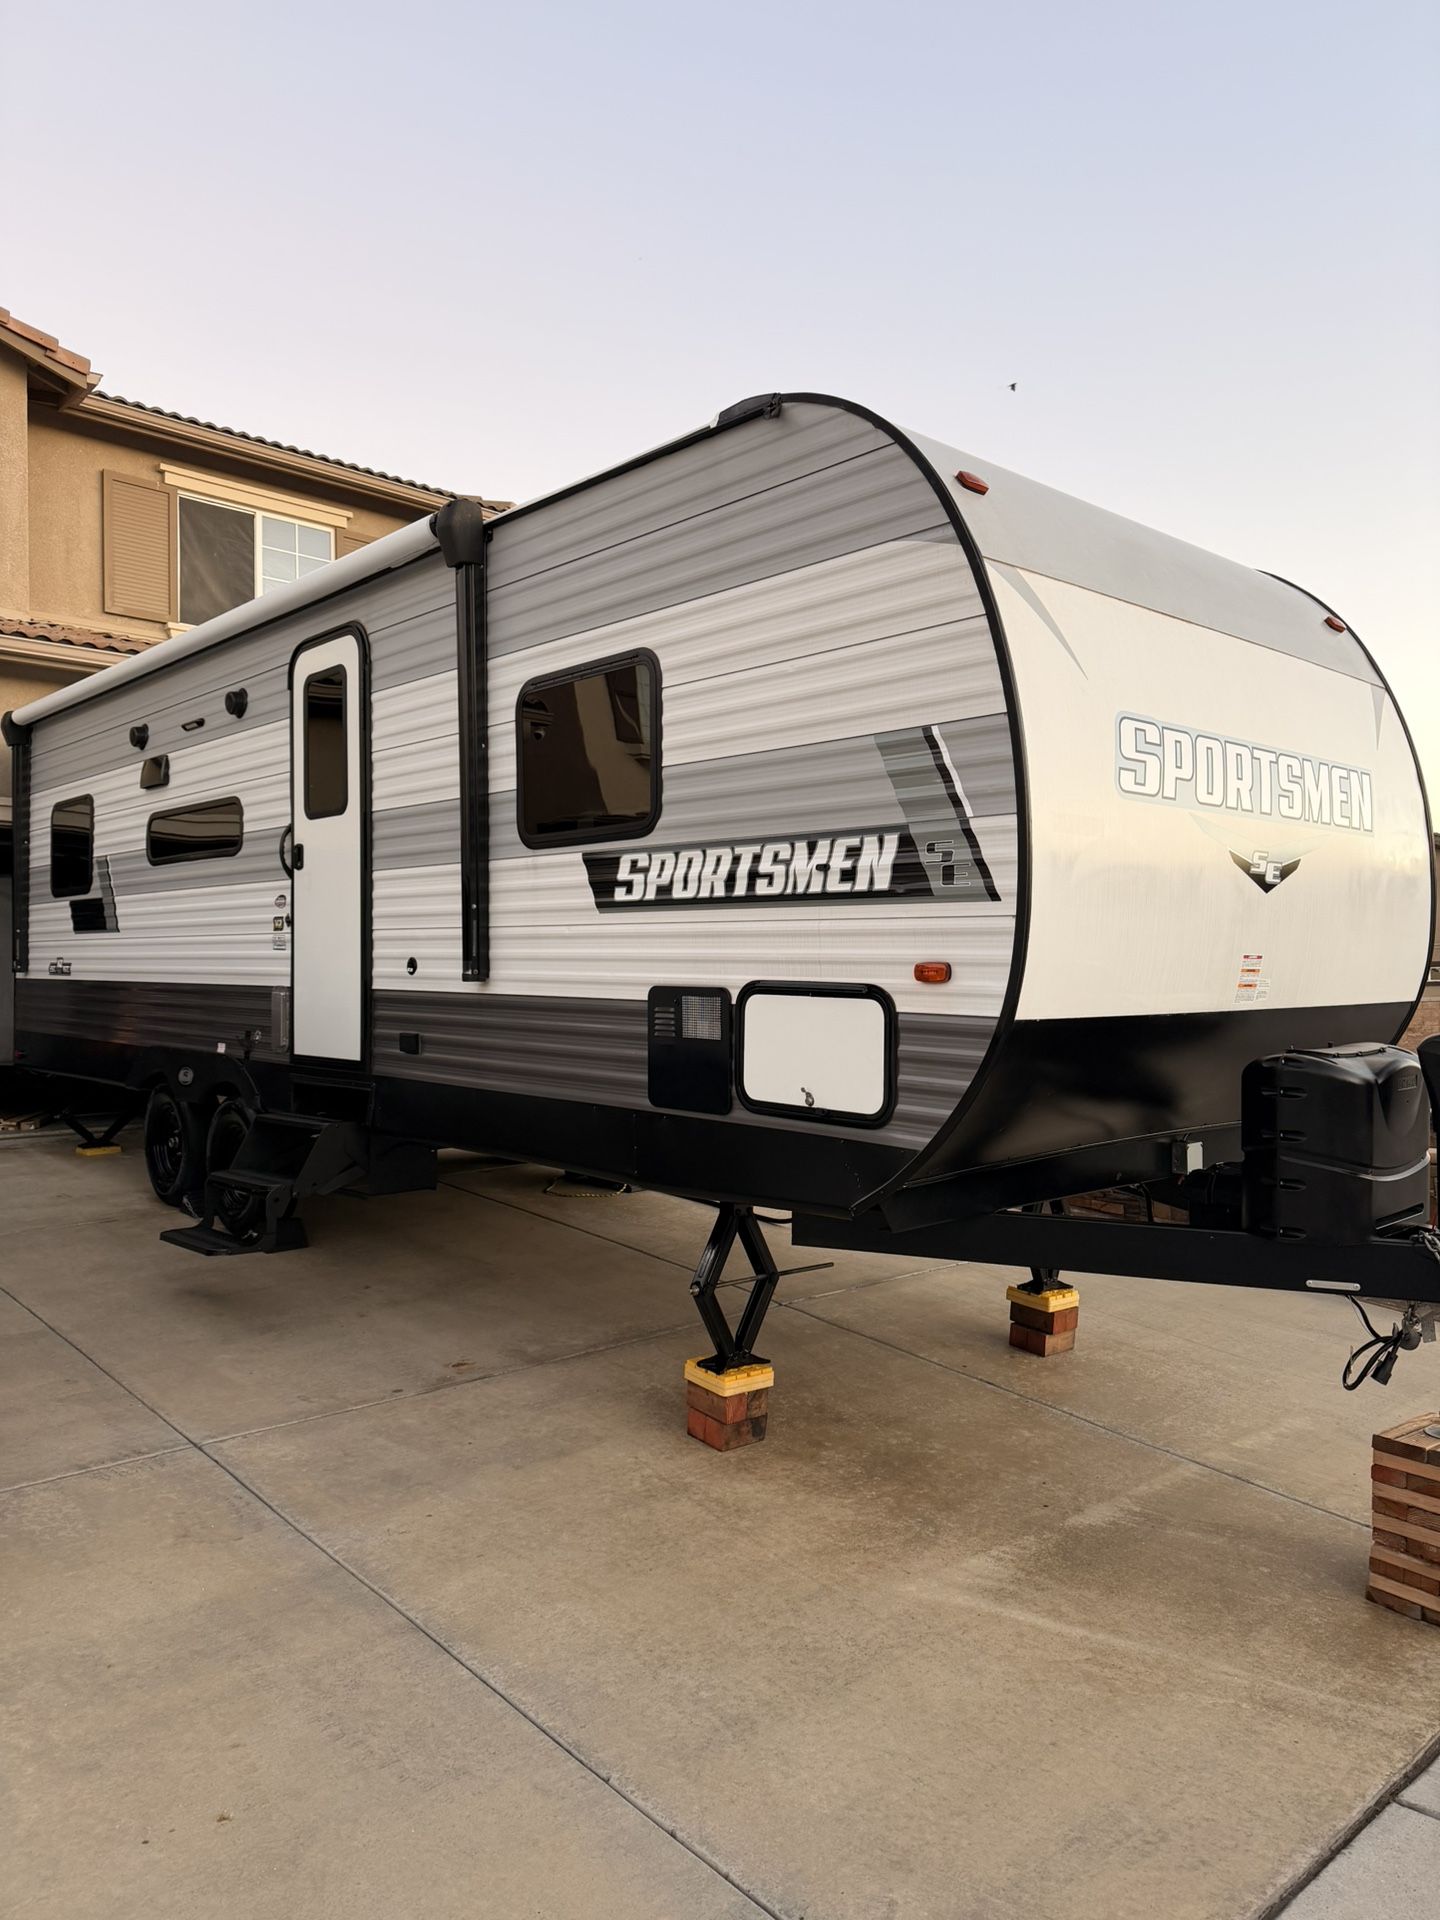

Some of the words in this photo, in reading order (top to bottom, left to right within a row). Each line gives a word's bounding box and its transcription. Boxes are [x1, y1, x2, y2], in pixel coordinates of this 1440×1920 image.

[1118, 716, 1373, 832] SPORTSMEN
[613, 834, 899, 902] SPORTSMEN
[925, 840, 972, 887] SE
[1250, 851, 1283, 885] SE
